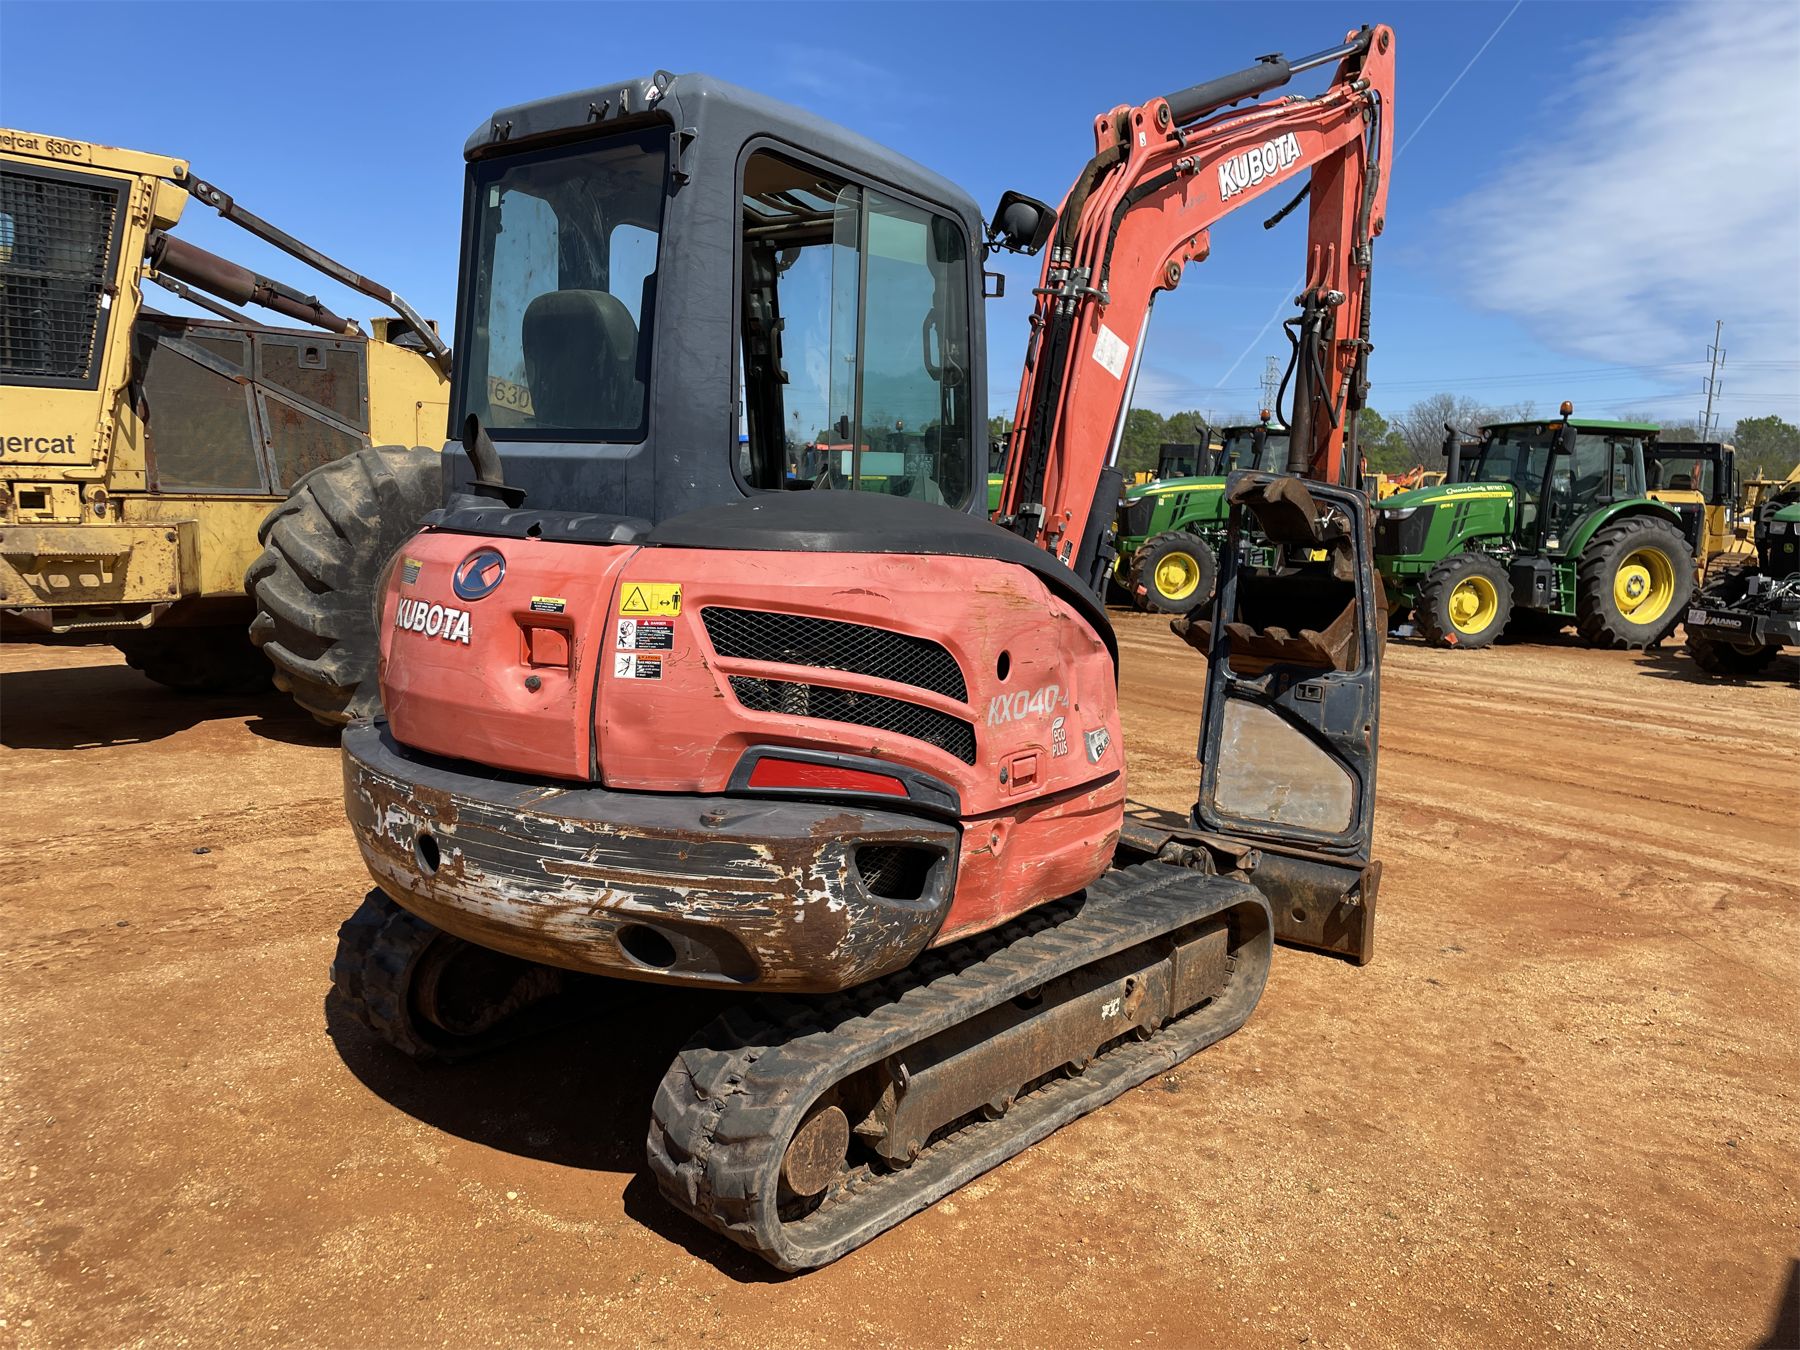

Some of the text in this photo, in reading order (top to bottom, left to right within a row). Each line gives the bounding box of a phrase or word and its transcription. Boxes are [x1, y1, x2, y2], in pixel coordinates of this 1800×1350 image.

[0, 134, 82, 157] ercat 630C
[1218, 131, 1302, 201] KUBOTA
[395, 598, 470, 644] KUBOTA
[1711, 616, 1742, 627] ALAMO
[1053, 728, 1067, 742] eco
[1052, 741, 1068, 758] PLUS
